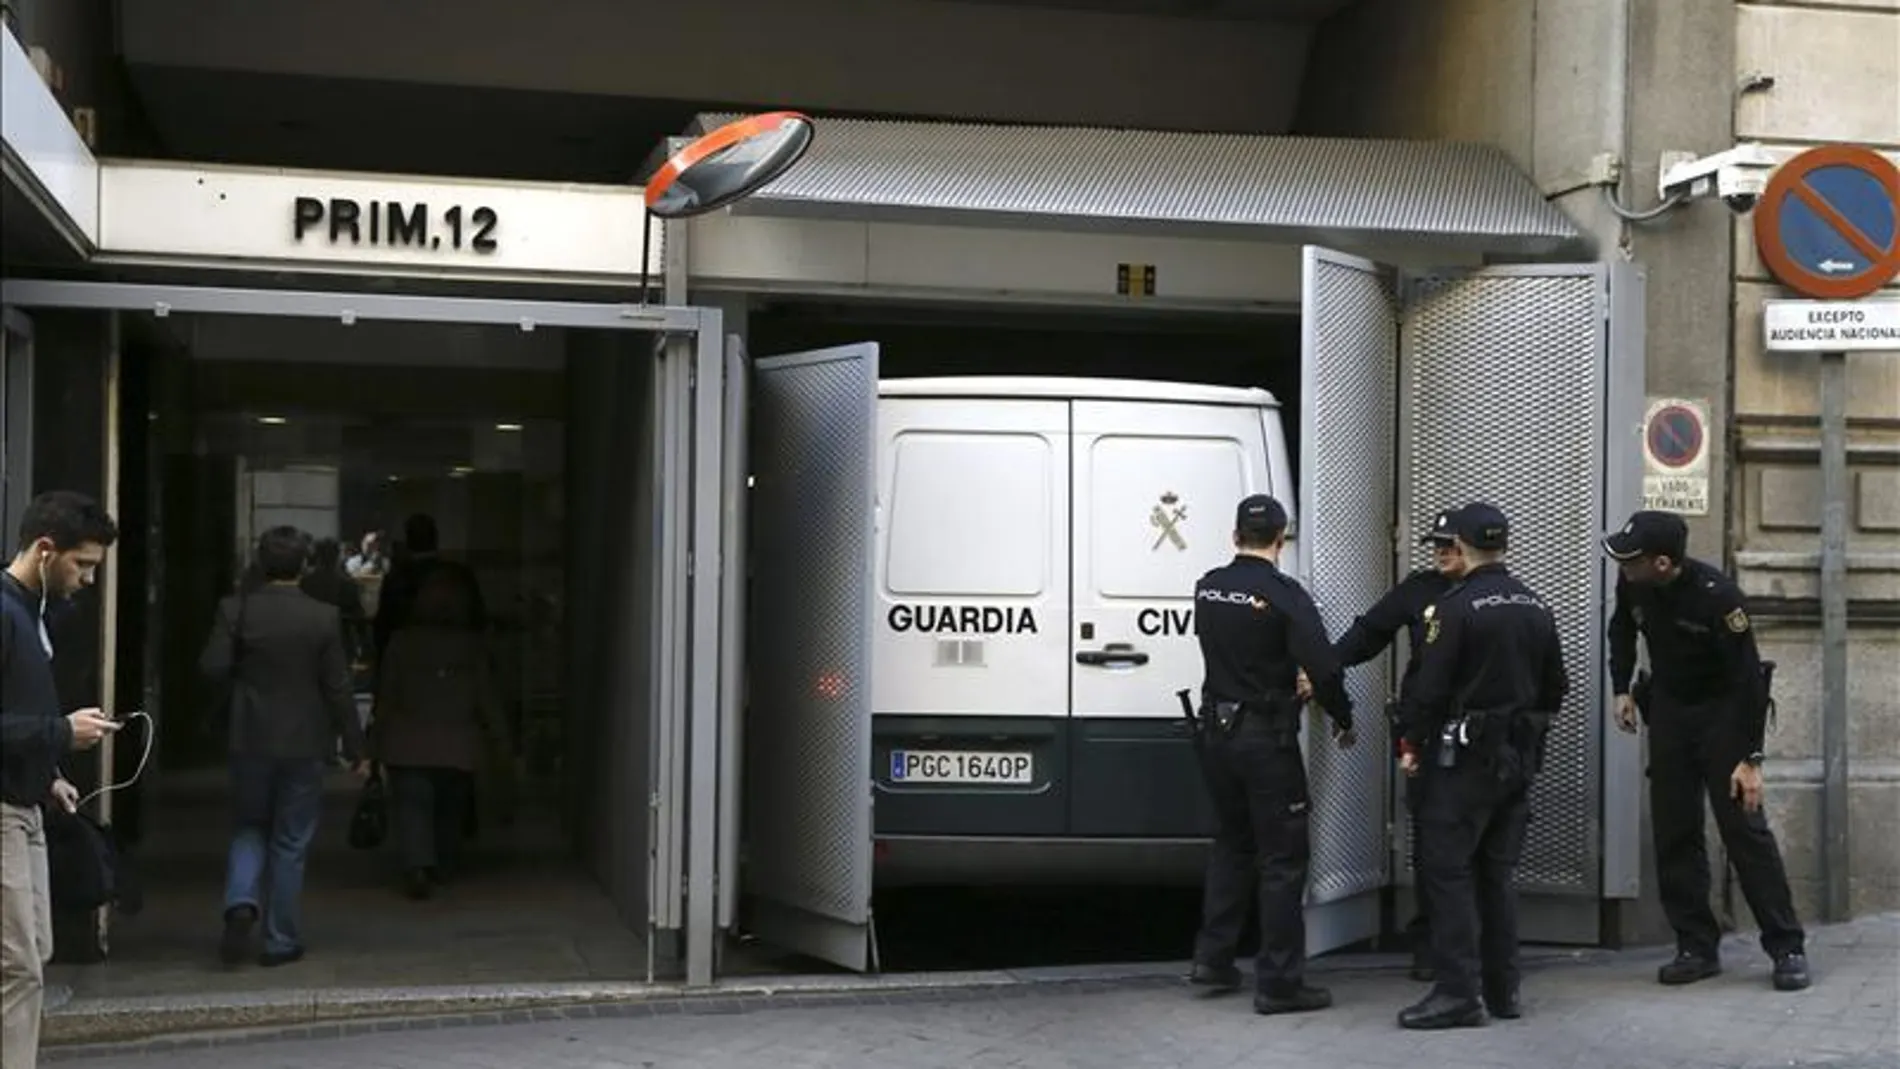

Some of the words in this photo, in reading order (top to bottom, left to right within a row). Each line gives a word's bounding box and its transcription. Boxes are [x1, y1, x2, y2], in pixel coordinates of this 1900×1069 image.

[1808, 310, 1865, 323] EXCEPTO
[1771, 328, 1835, 340] AUDIENCIA
[1198, 589, 1255, 605] POLICIA
[888, 604, 1038, 634] GUARDIA
[1137, 607, 1199, 636] CIV
